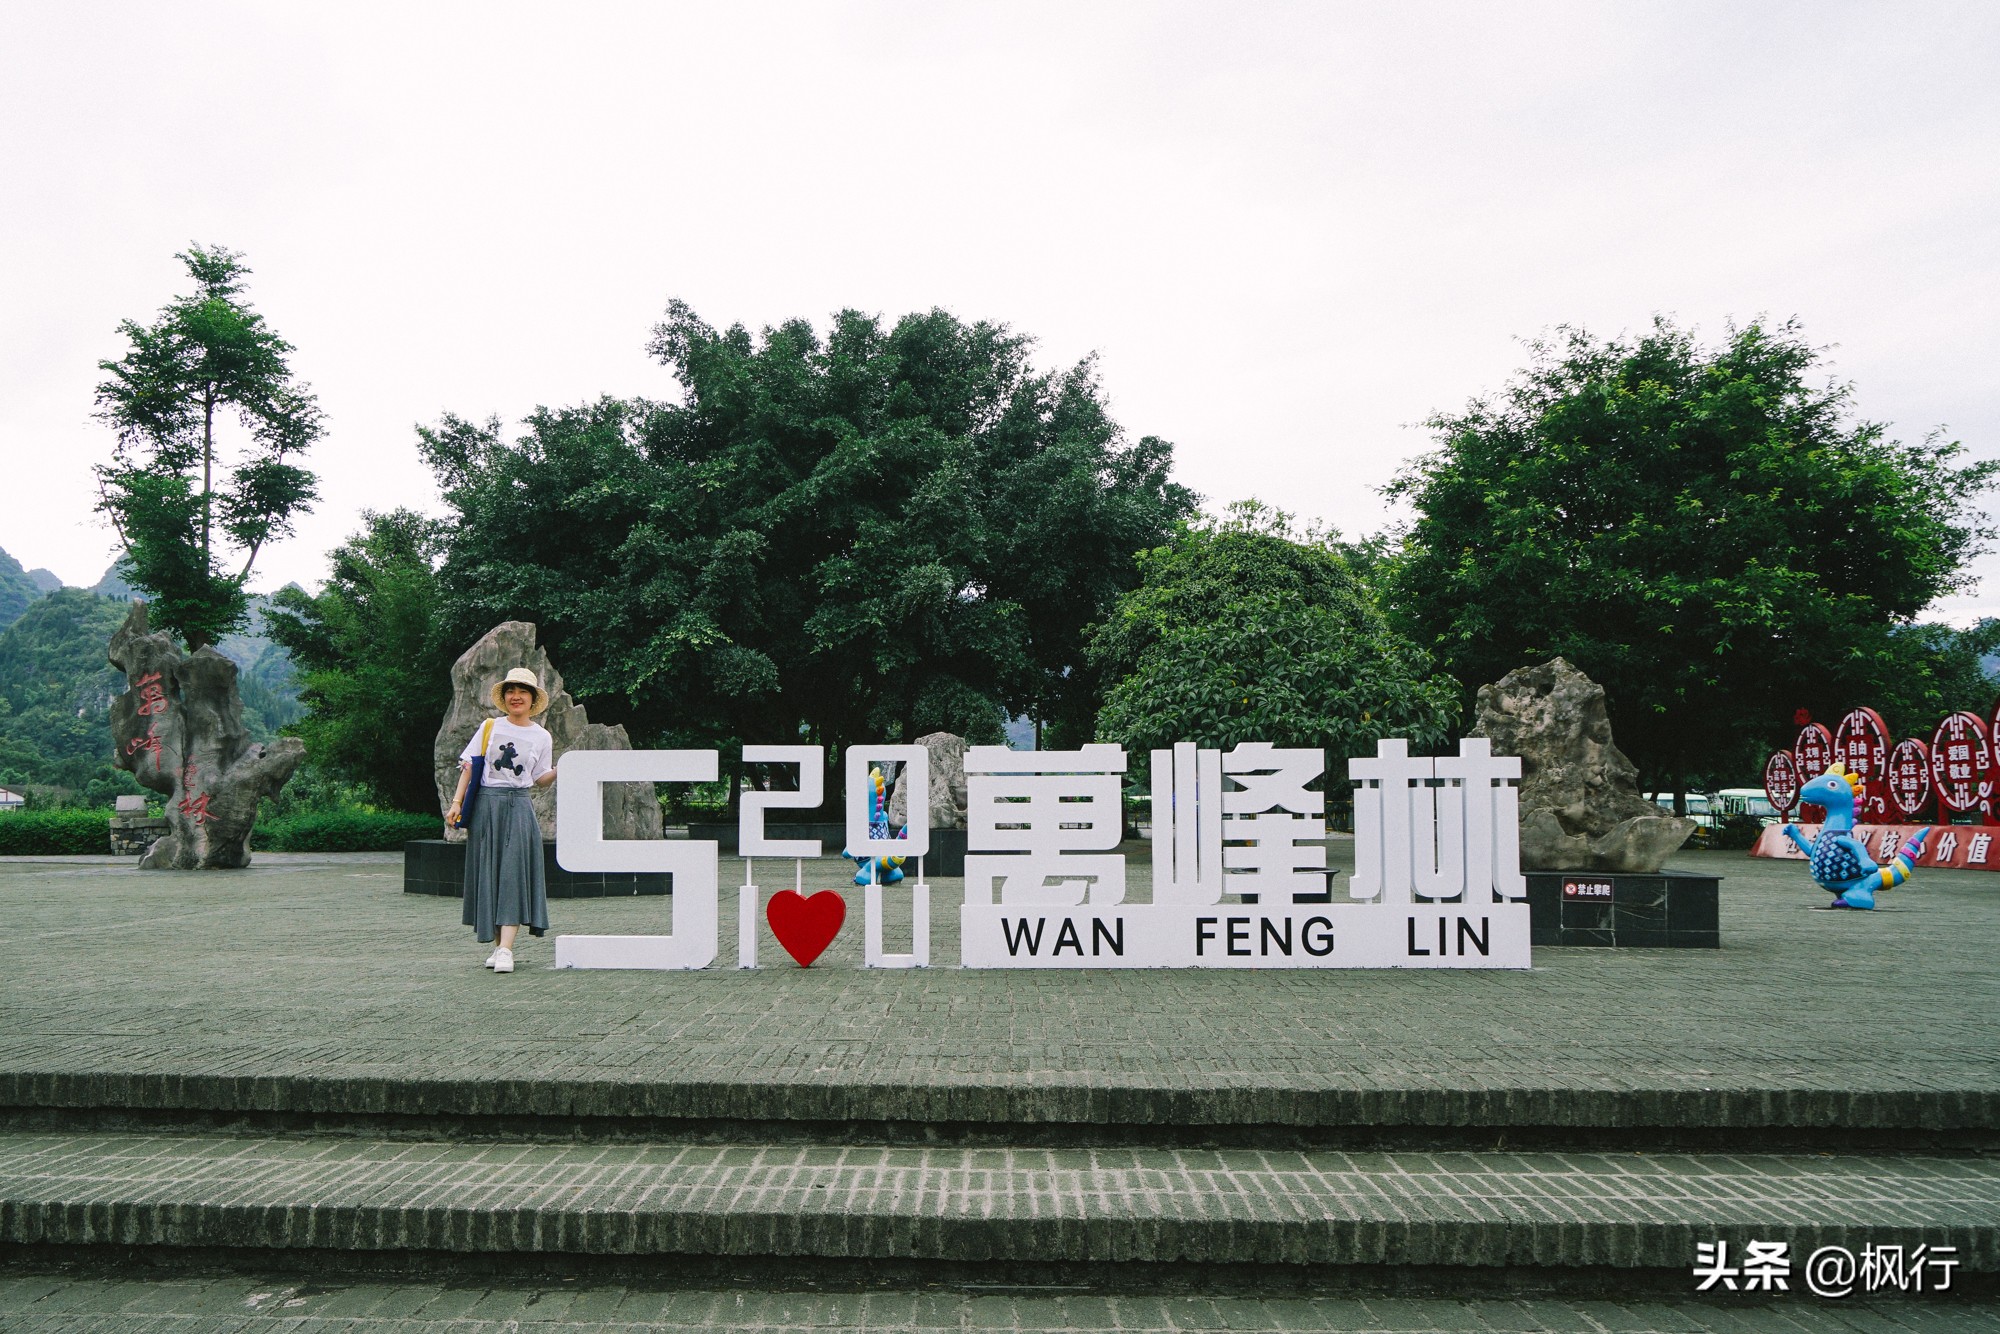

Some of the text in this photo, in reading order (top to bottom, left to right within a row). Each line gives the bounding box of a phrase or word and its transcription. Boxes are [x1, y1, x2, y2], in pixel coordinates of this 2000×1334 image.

[1849, 740, 1867, 756] 自由
[1948, 745, 1970, 761] 爱国
[1849, 758, 1868, 774] 平等
[1901, 764, 1917, 775] 公正
[1949, 764, 1972, 779] 敬业
[1901, 778, 1918, 790] 法治
[963, 738, 1528, 905] 萬峰林
[1577, 883, 1611, 896] 禁止攀爬
[1001, 916, 1490, 957] WAN FENG LIN
